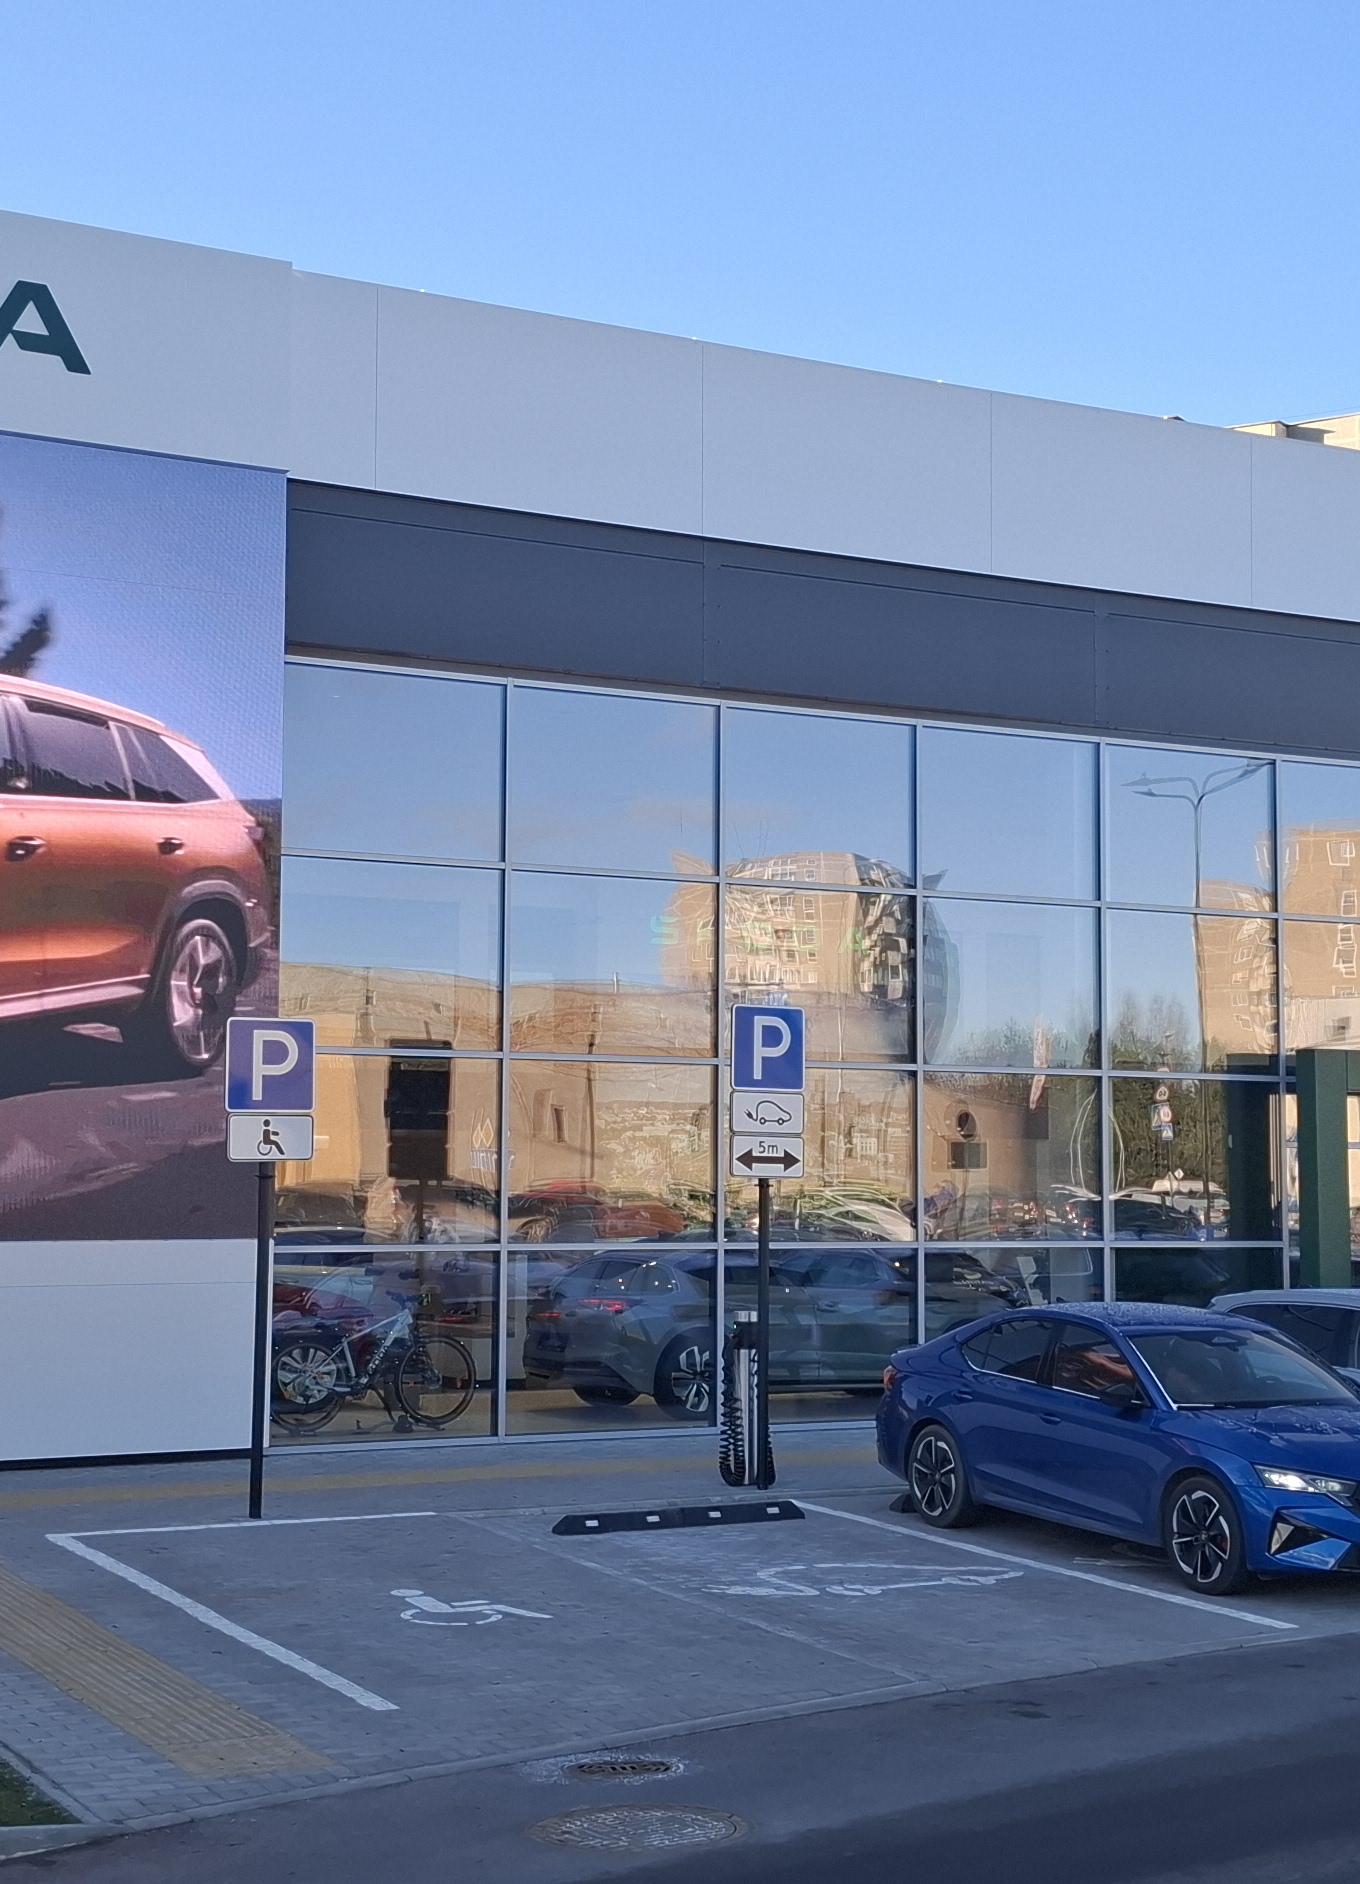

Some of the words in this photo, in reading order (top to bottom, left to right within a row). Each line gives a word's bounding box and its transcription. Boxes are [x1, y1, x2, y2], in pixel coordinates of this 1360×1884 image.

[252, 1029, 299, 1101] P
[753, 1015, 791, 1080] P
[758, 1140, 779, 1154] 5m
